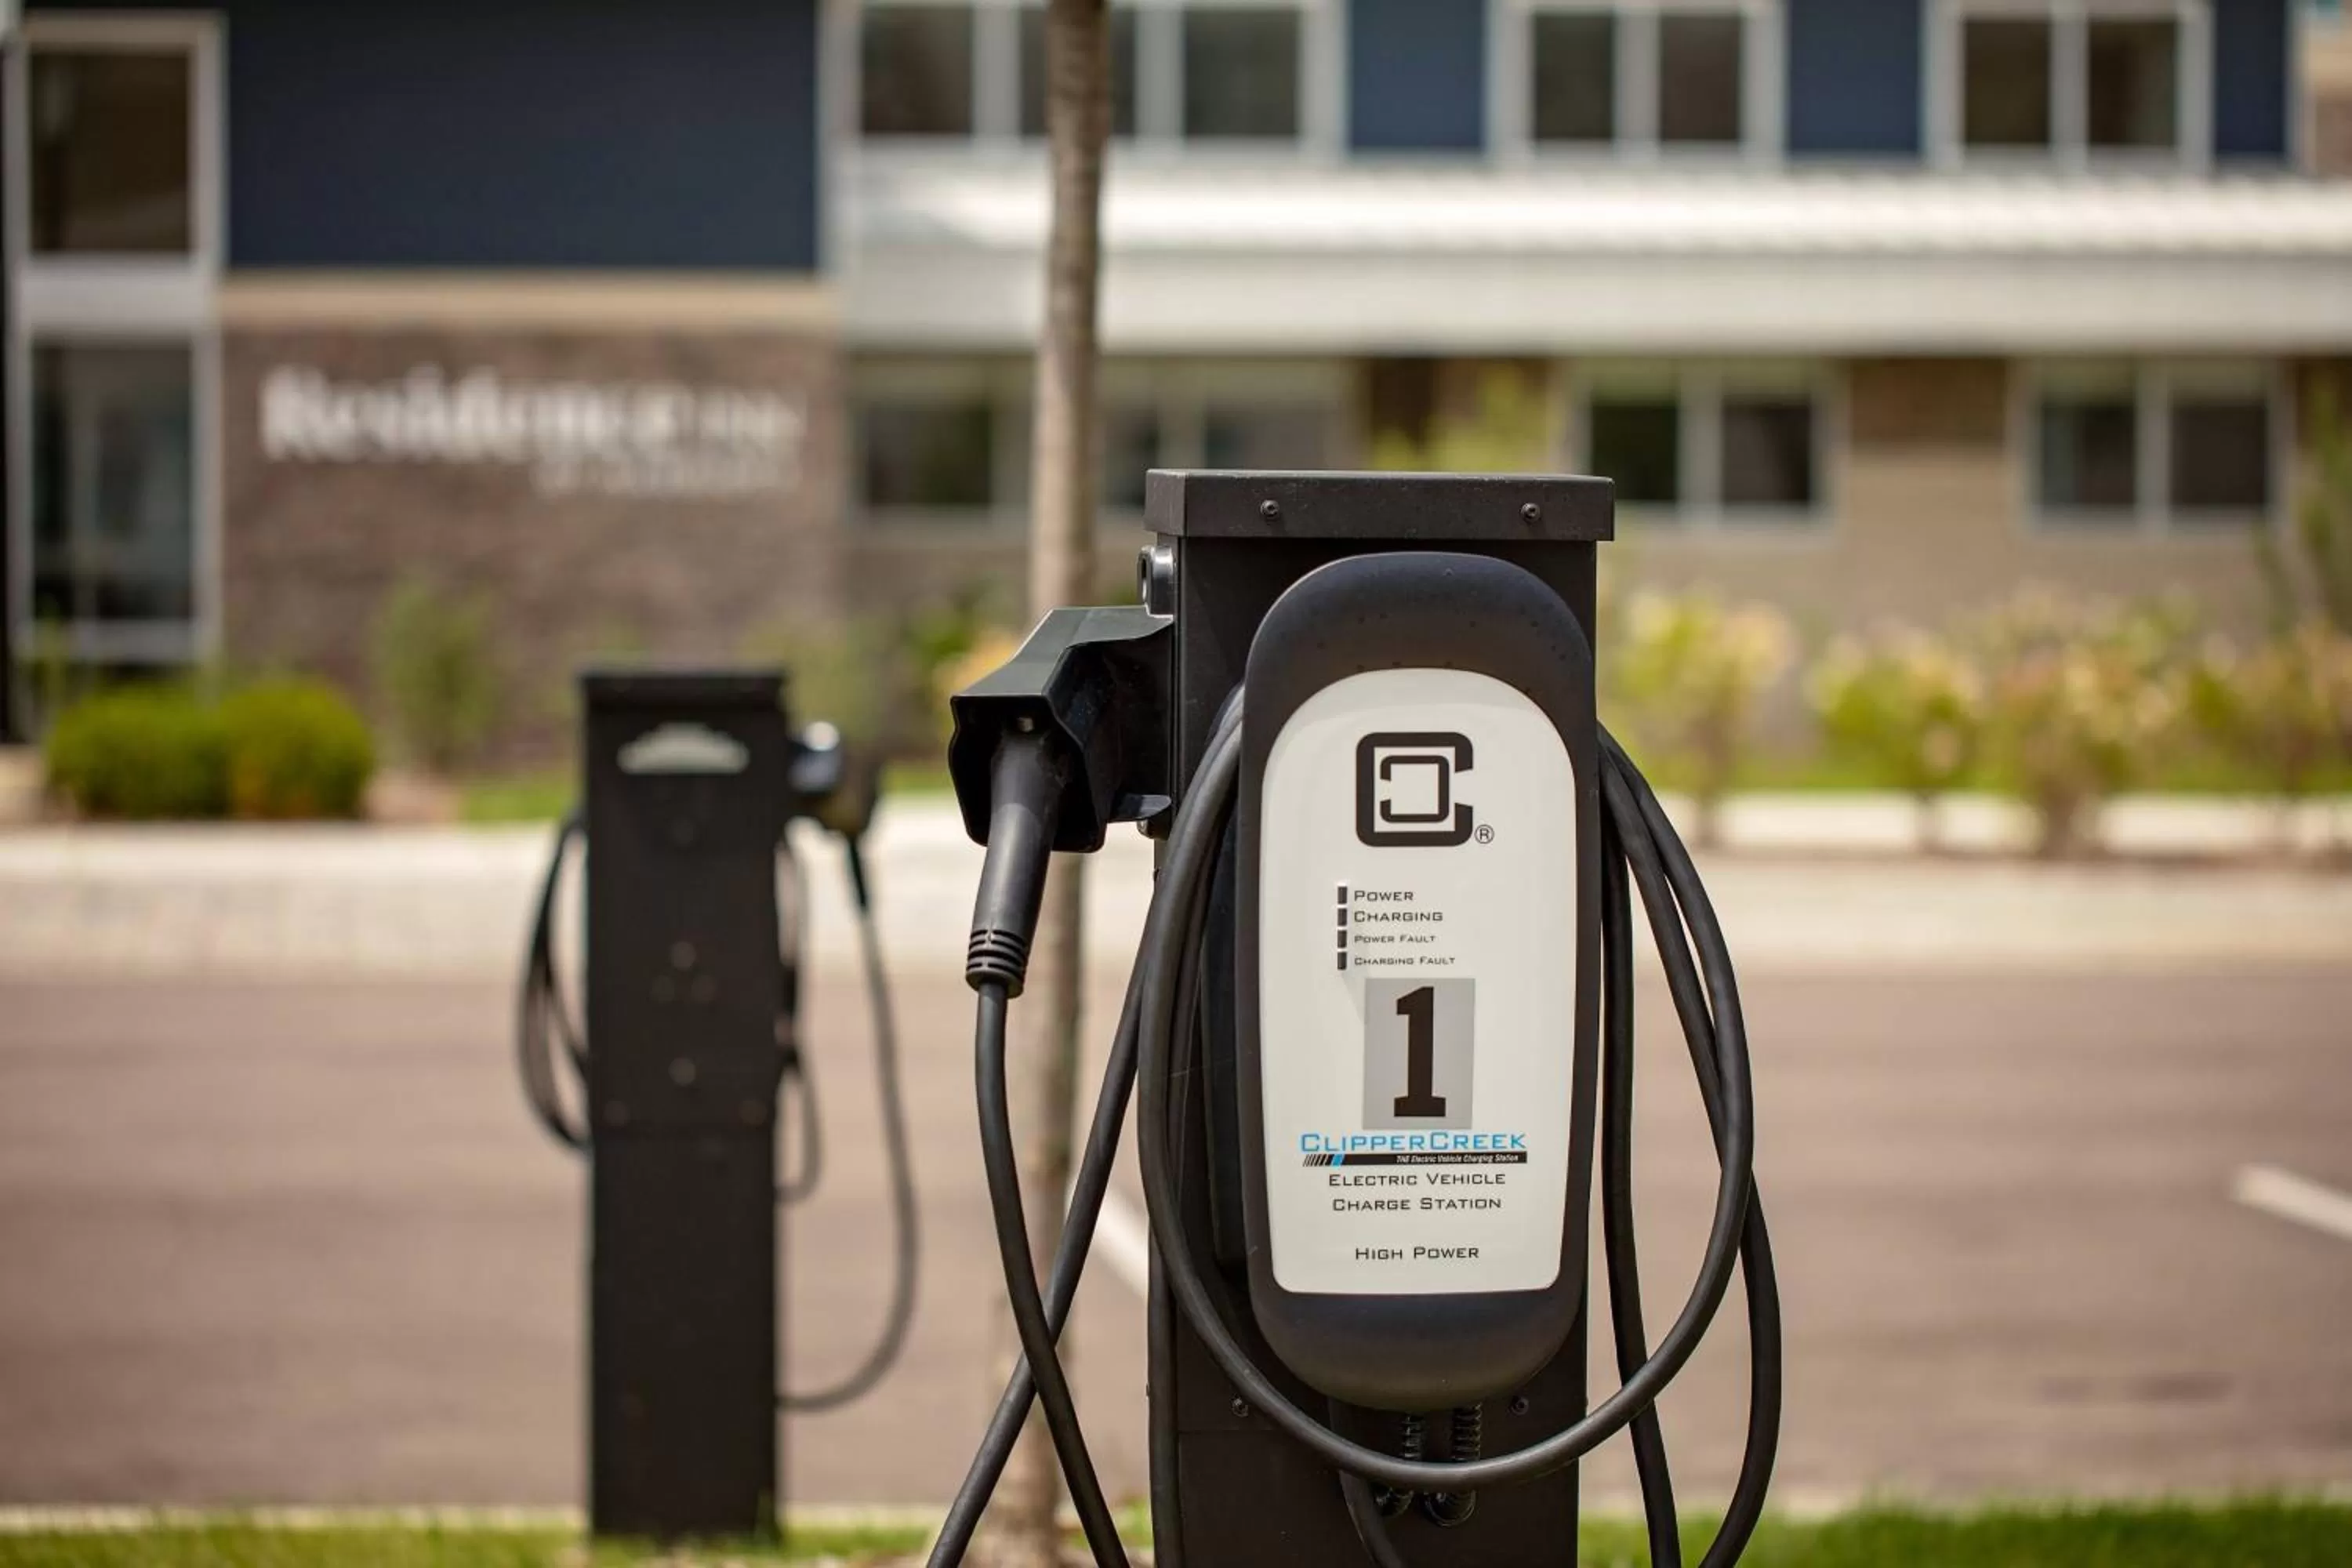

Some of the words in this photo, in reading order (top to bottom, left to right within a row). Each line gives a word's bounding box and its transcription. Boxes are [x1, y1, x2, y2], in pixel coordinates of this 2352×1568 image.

[260, 365, 693, 463] Residence
[1354, 890, 1414, 902] POWER
[1354, 910, 1443, 923] CHARGING
[1354, 935, 1395, 944] POWER
[1399, 935, 1436, 943] FAULT
[1354, 956, 1414, 966] CHARGING
[1419, 956, 1456, 965] FAULT
[1393, 985, 1446, 1118] 1
[1463, 1154, 1494, 1163] Charging
[1494, 1153, 1519, 1162] Station
[1329, 1174, 1417, 1187] ELECTRIC
[1426, 1173, 1506, 1185] VEHICLE
[1332, 1199, 1410, 1211] CHARGE
[1420, 1197, 1501, 1210] STATION
[1356, 1247, 1403, 1260] HIGH
[1414, 1247, 1479, 1259] POWER
